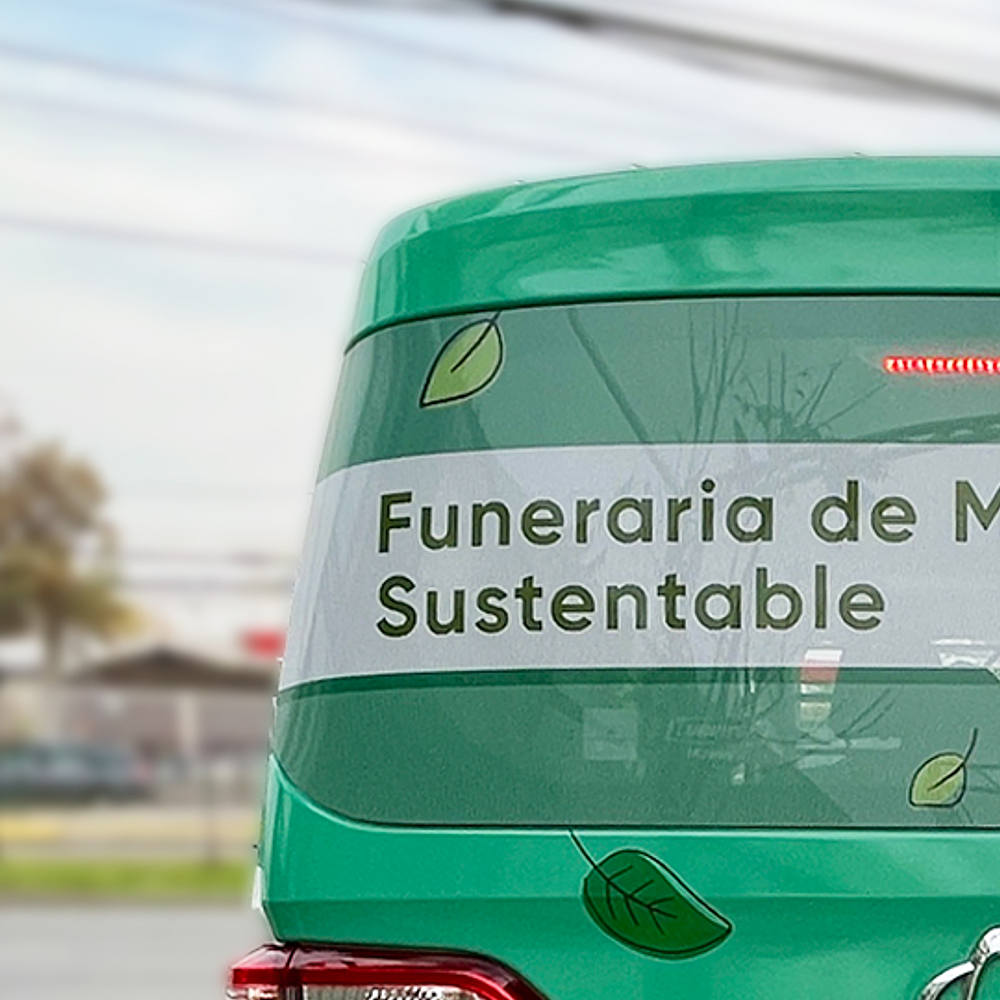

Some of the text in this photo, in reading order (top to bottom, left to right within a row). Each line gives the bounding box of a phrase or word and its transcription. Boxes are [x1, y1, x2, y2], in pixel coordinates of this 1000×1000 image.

[377, 479, 774, 553] Funeraria
[810, 480, 917, 543] de
[375, 564, 886, 637] Sustentable
